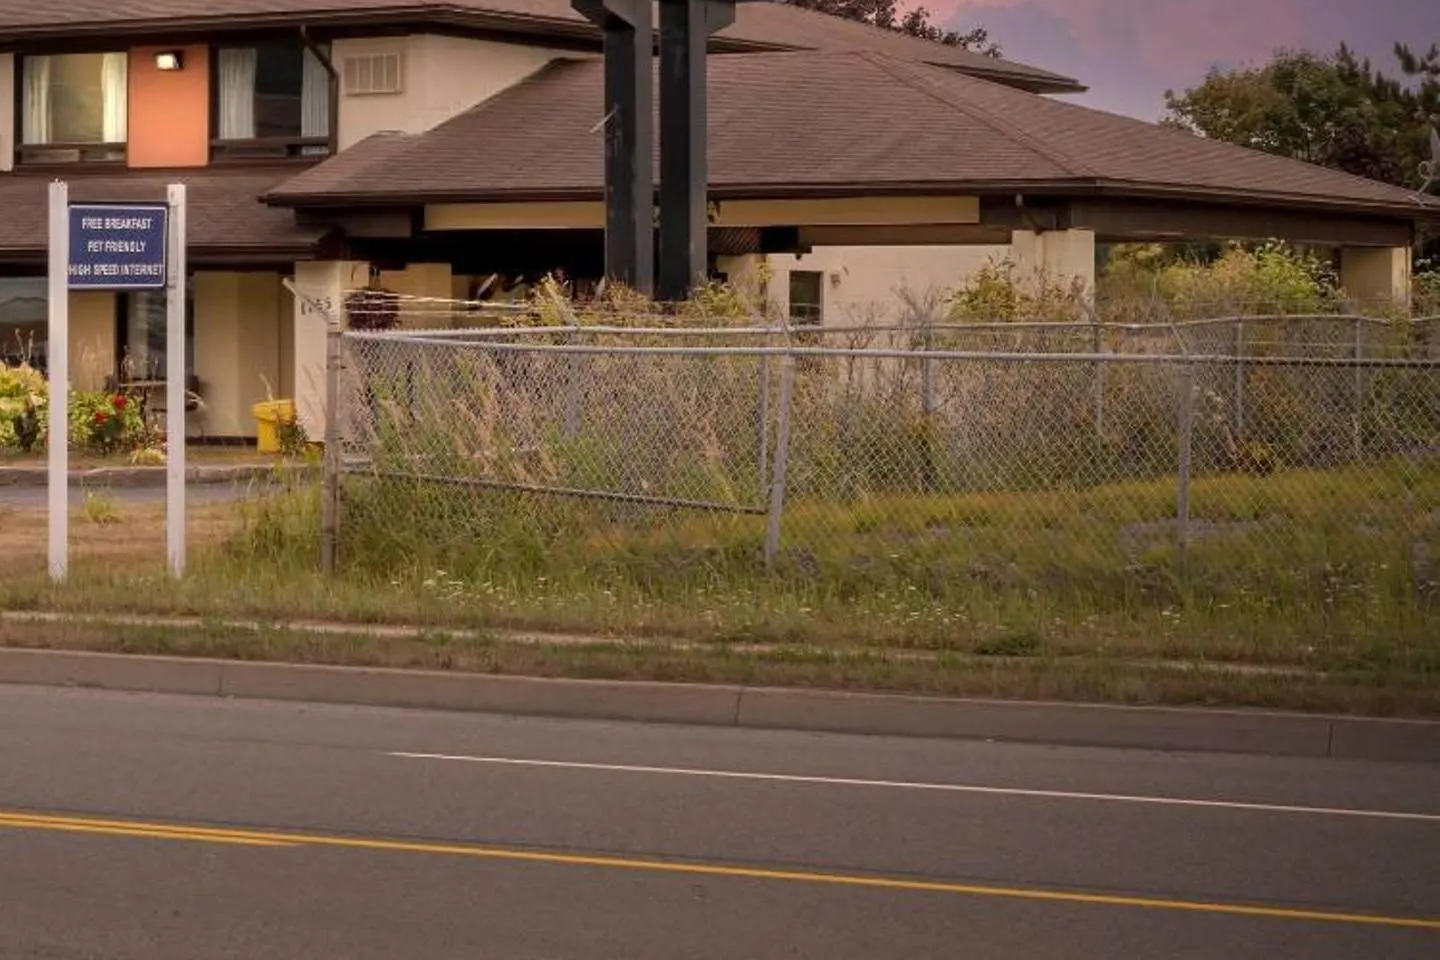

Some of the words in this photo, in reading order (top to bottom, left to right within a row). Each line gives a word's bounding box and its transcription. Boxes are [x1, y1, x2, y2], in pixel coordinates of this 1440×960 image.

[82, 217, 103, 230] FREE
[104, 218, 152, 230] BREAKFAST
[88, 240, 104, 252] PET
[105, 240, 147, 253] FRIENDLY
[68, 264, 92, 276] HIGH
[93, 264, 120, 276] SPEED
[120, 264, 164, 276] INTERNET
